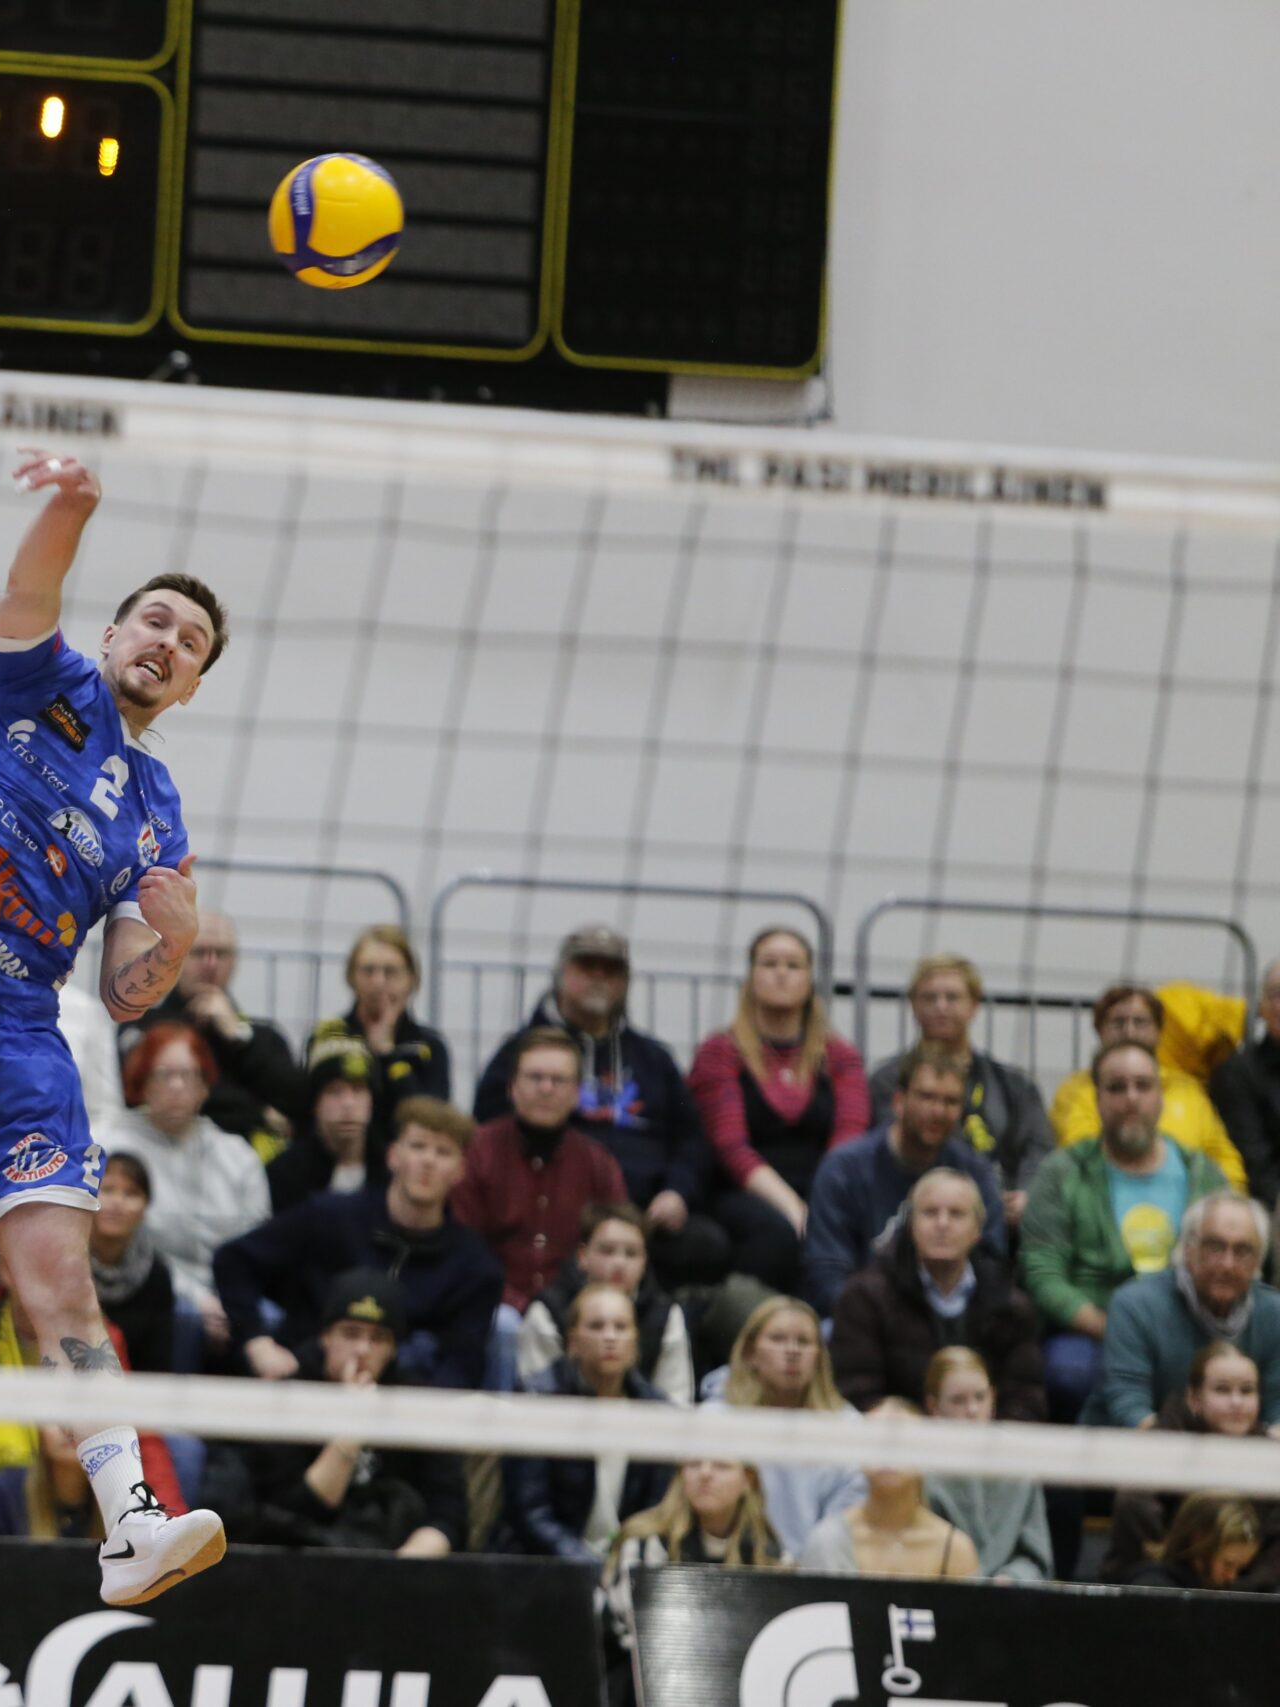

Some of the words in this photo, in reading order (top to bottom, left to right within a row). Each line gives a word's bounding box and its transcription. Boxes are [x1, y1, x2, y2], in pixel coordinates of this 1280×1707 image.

[90, 754, 129, 821] 2
[68, 825, 102, 858] AKAA
[82, 1143, 101, 1190] 2
